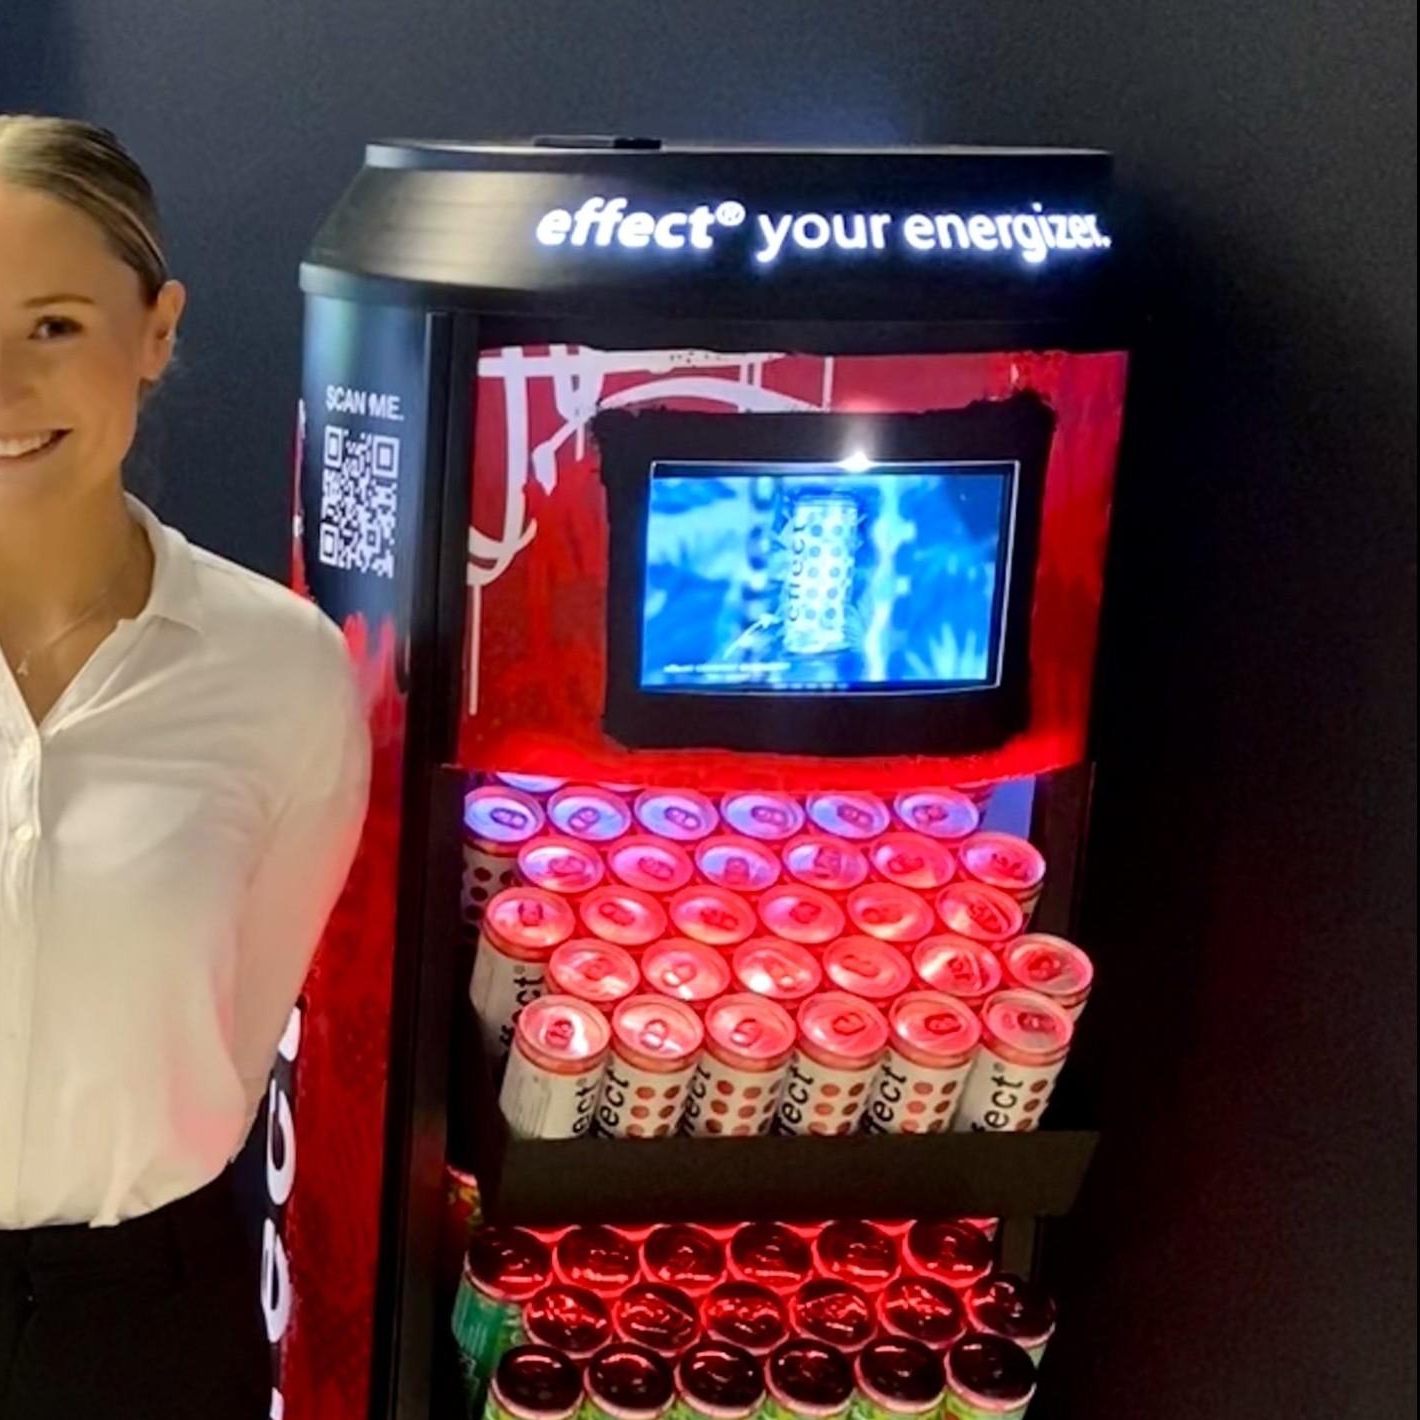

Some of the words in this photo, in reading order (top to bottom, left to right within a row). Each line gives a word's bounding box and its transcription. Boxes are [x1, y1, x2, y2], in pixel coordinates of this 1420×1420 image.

[756, 213, 891, 263] your
[903, 202, 1111, 263] energizer.
[325, 385, 367, 415] SCAN
[368, 393, 405, 420] ME.
